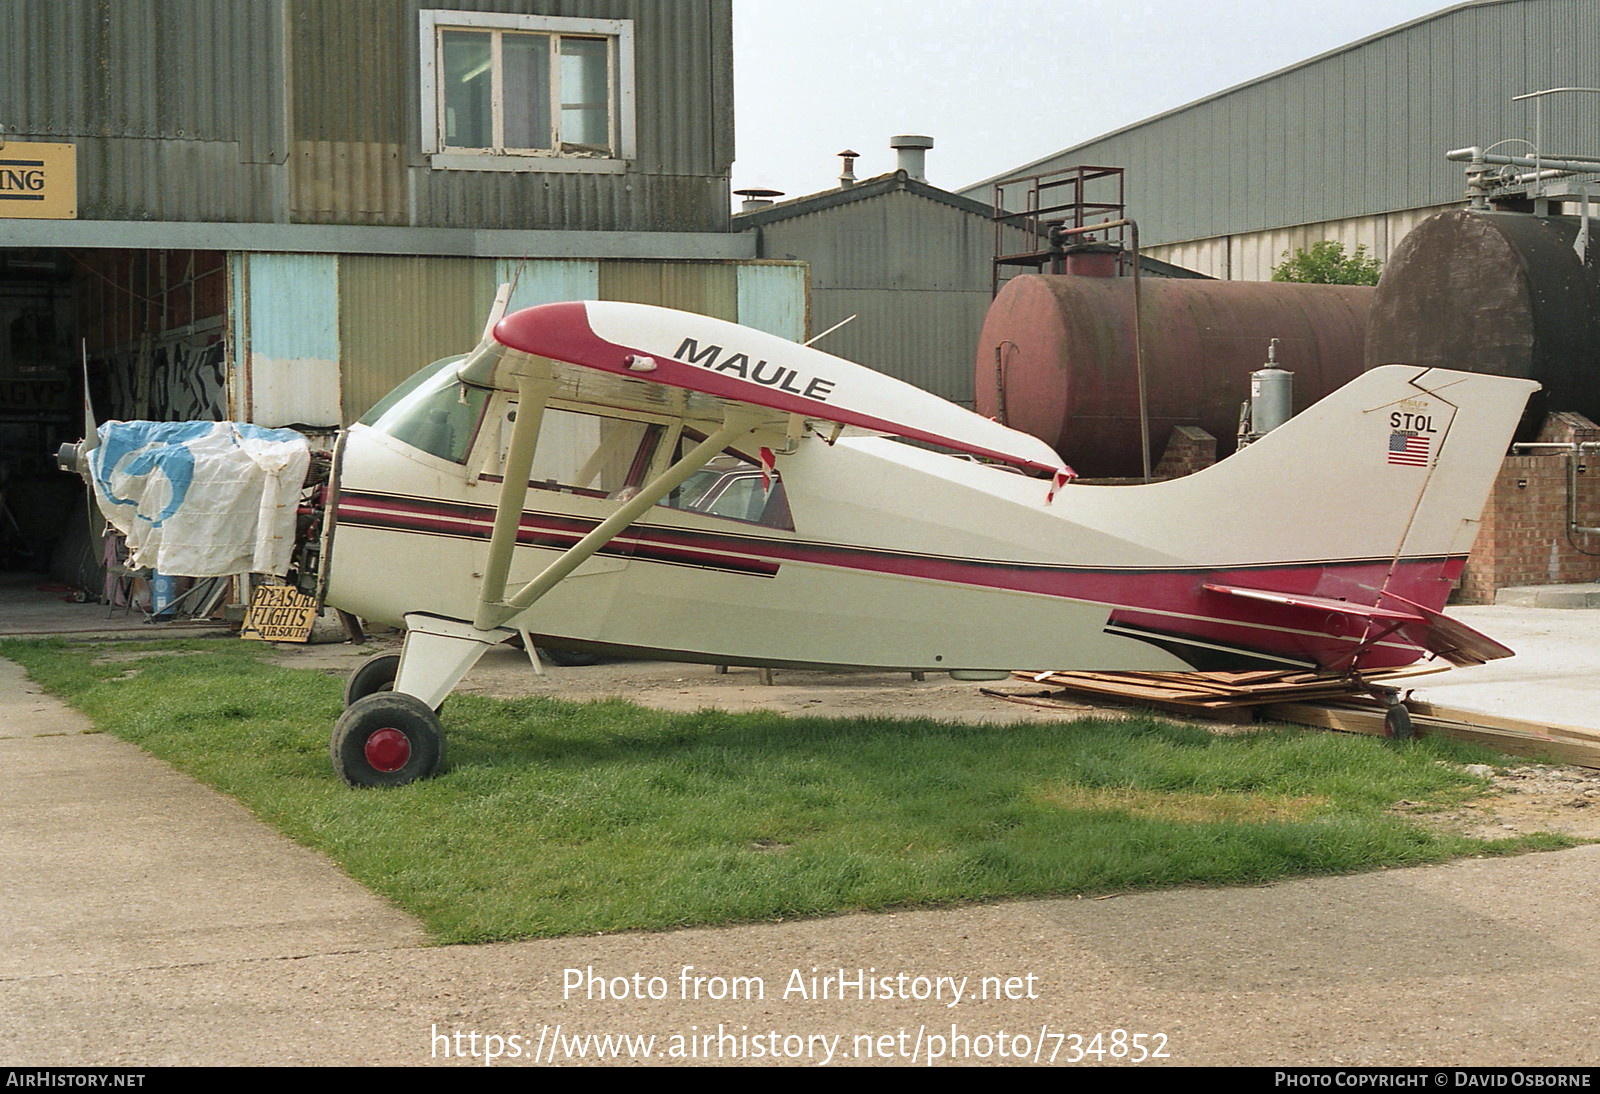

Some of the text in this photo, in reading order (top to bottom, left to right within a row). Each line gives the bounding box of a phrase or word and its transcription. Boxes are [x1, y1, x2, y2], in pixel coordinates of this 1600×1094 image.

[0, 169, 44, 191] ING
[673, 337, 836, 401] MAULE
[1390, 411, 1437, 433] STOL
[252, 606, 309, 627] FLIGHTS
[260, 625, 277, 637] AIR
